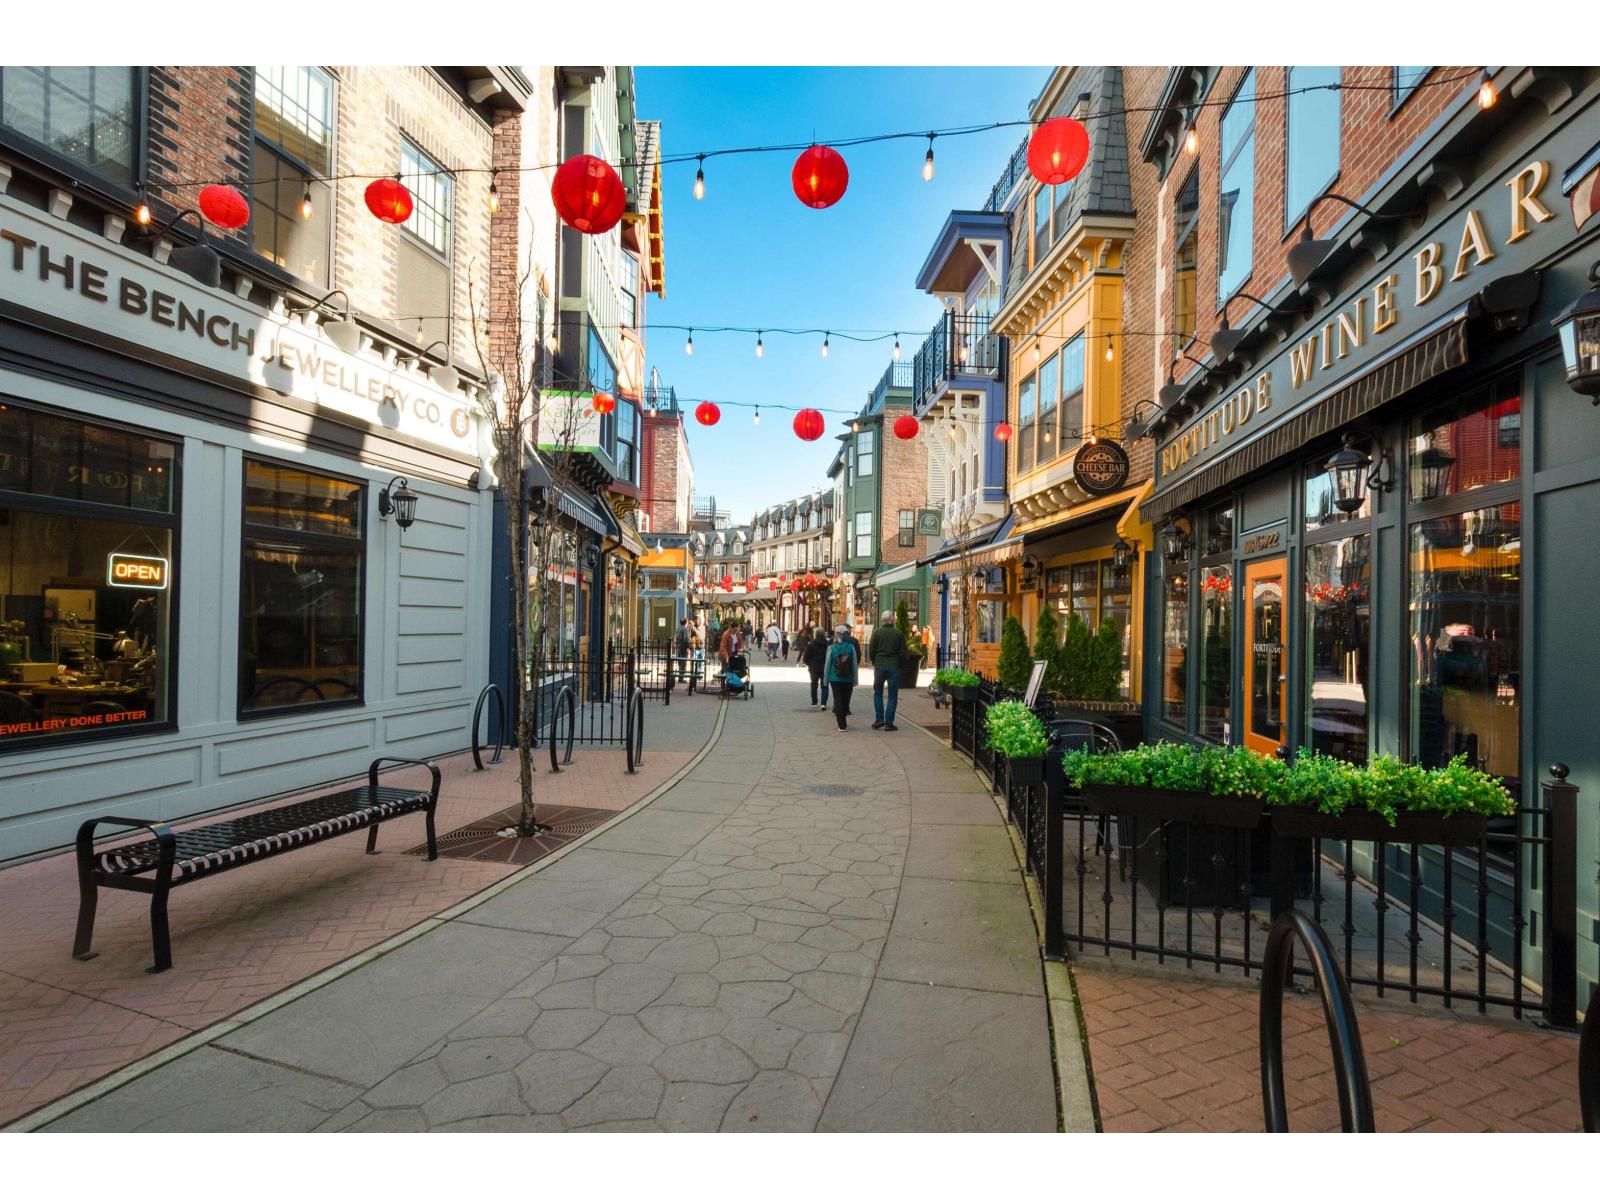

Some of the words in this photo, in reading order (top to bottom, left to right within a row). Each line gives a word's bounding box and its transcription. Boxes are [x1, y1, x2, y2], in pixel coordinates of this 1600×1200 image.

[2, 229, 108, 302] THE
[119, 276, 255, 357] BENCH
[261, 337, 409, 414] JEWELLERY
[413, 398, 445, 428] CO.
[1161, 371, 1273, 478] FORTITUDE
[1289, 274, 1398, 391] WINE
[1413, 160, 1557, 308] BAR
[1076, 462, 1108, 472] CHEESE
[1109, 463, 1125, 473] BAR
[115, 563, 161, 581] OPEN
[0, 719, 67, 736] EWELLERY
[70, 714, 103, 727] DONE
[105, 710, 147, 723] BETTER
